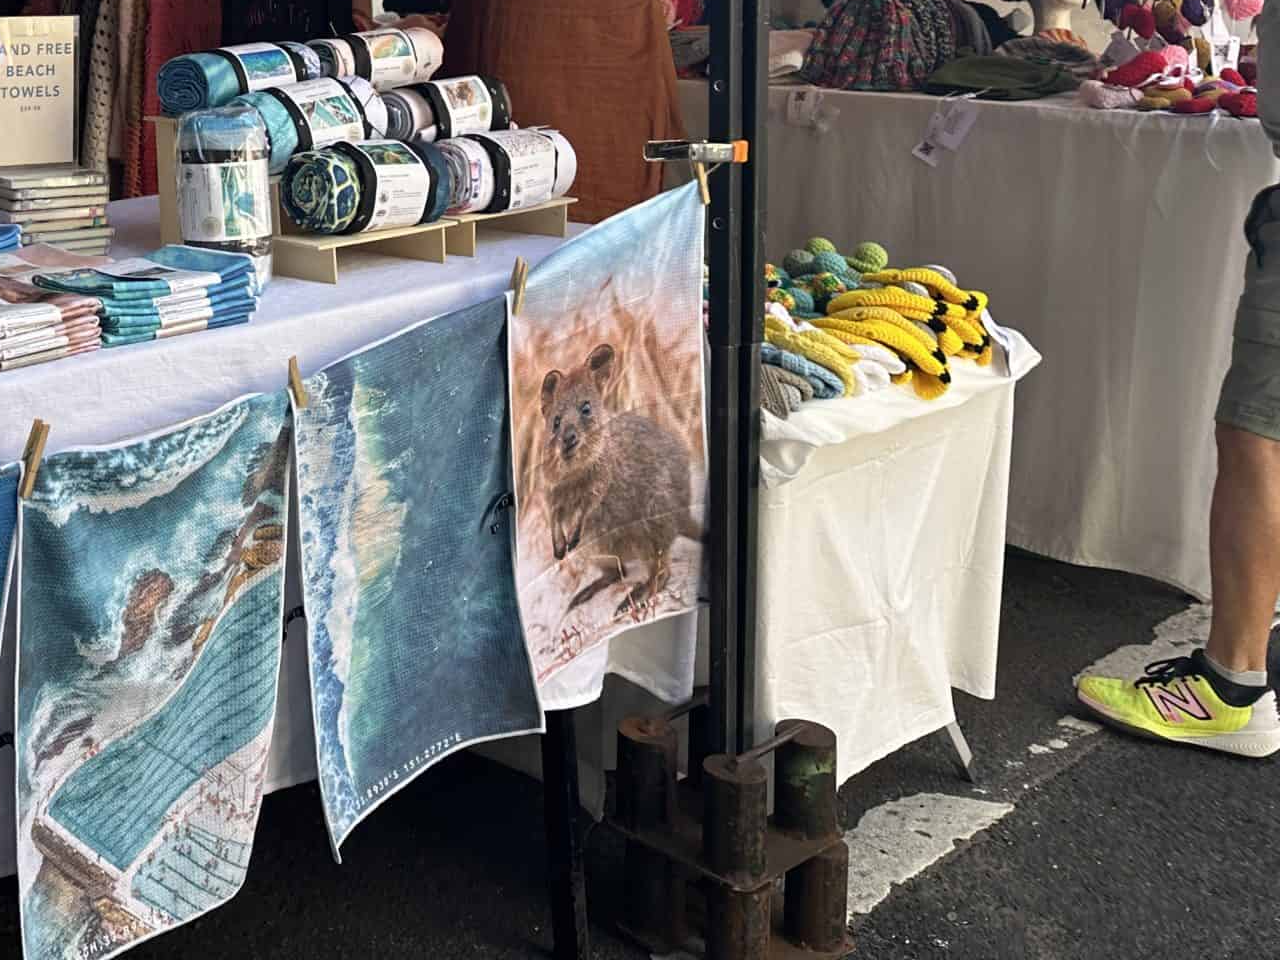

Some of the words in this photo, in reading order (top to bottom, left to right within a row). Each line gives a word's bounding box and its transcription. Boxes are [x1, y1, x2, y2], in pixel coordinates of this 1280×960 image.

[36, 42, 73, 55] FREE
[6, 63, 56, 78] BEACH
[0, 84, 61, 99] TOWELS
